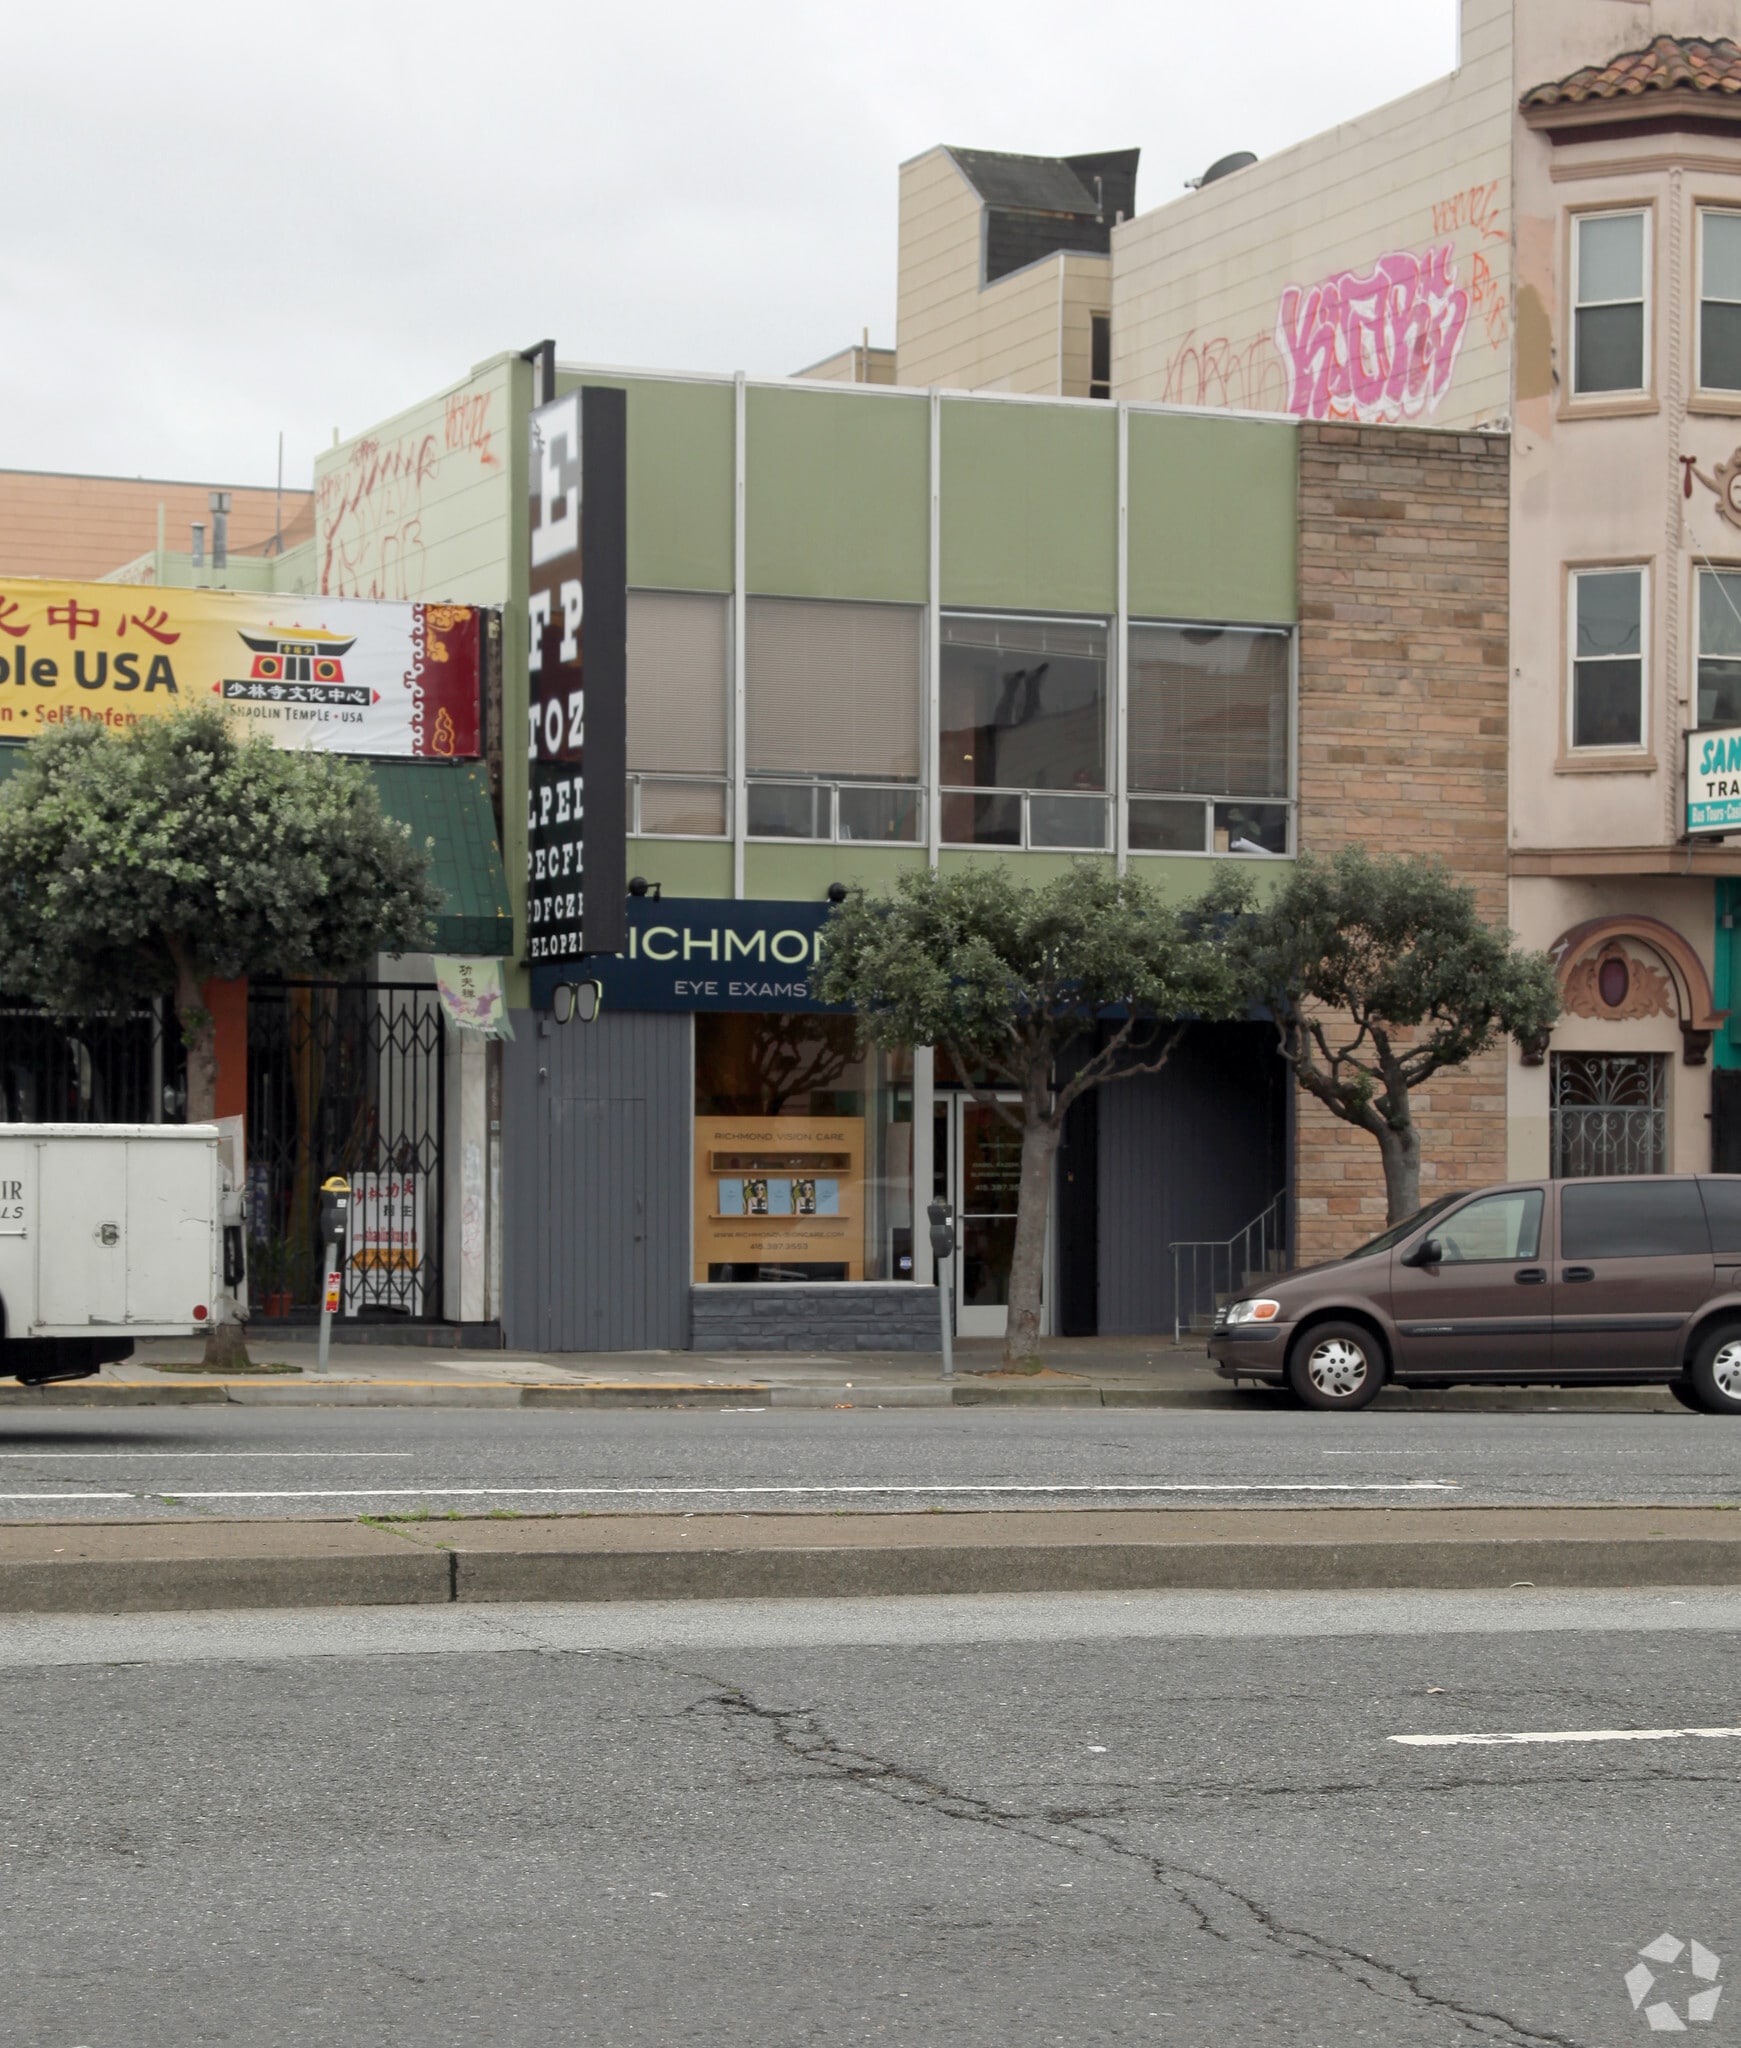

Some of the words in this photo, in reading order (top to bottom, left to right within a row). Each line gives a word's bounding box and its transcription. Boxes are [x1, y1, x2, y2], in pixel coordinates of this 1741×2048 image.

[532, 397, 578, 568] E
[75, 650, 179, 693] USA
[227, 682, 366, 703] 少林寺文化中心
[284, 707, 330, 721] TEMPLE
[341, 712, 363, 723] USA
[674, 980, 719, 996] EYE
[728, 982, 808, 998] EXAMS
[714, 1132, 773, 1141] RICHMOND
[776, 1133, 812, 1141] VISION
[815, 1133, 845, 1141] CARE
[1, 1206, 24, 1219] LS
